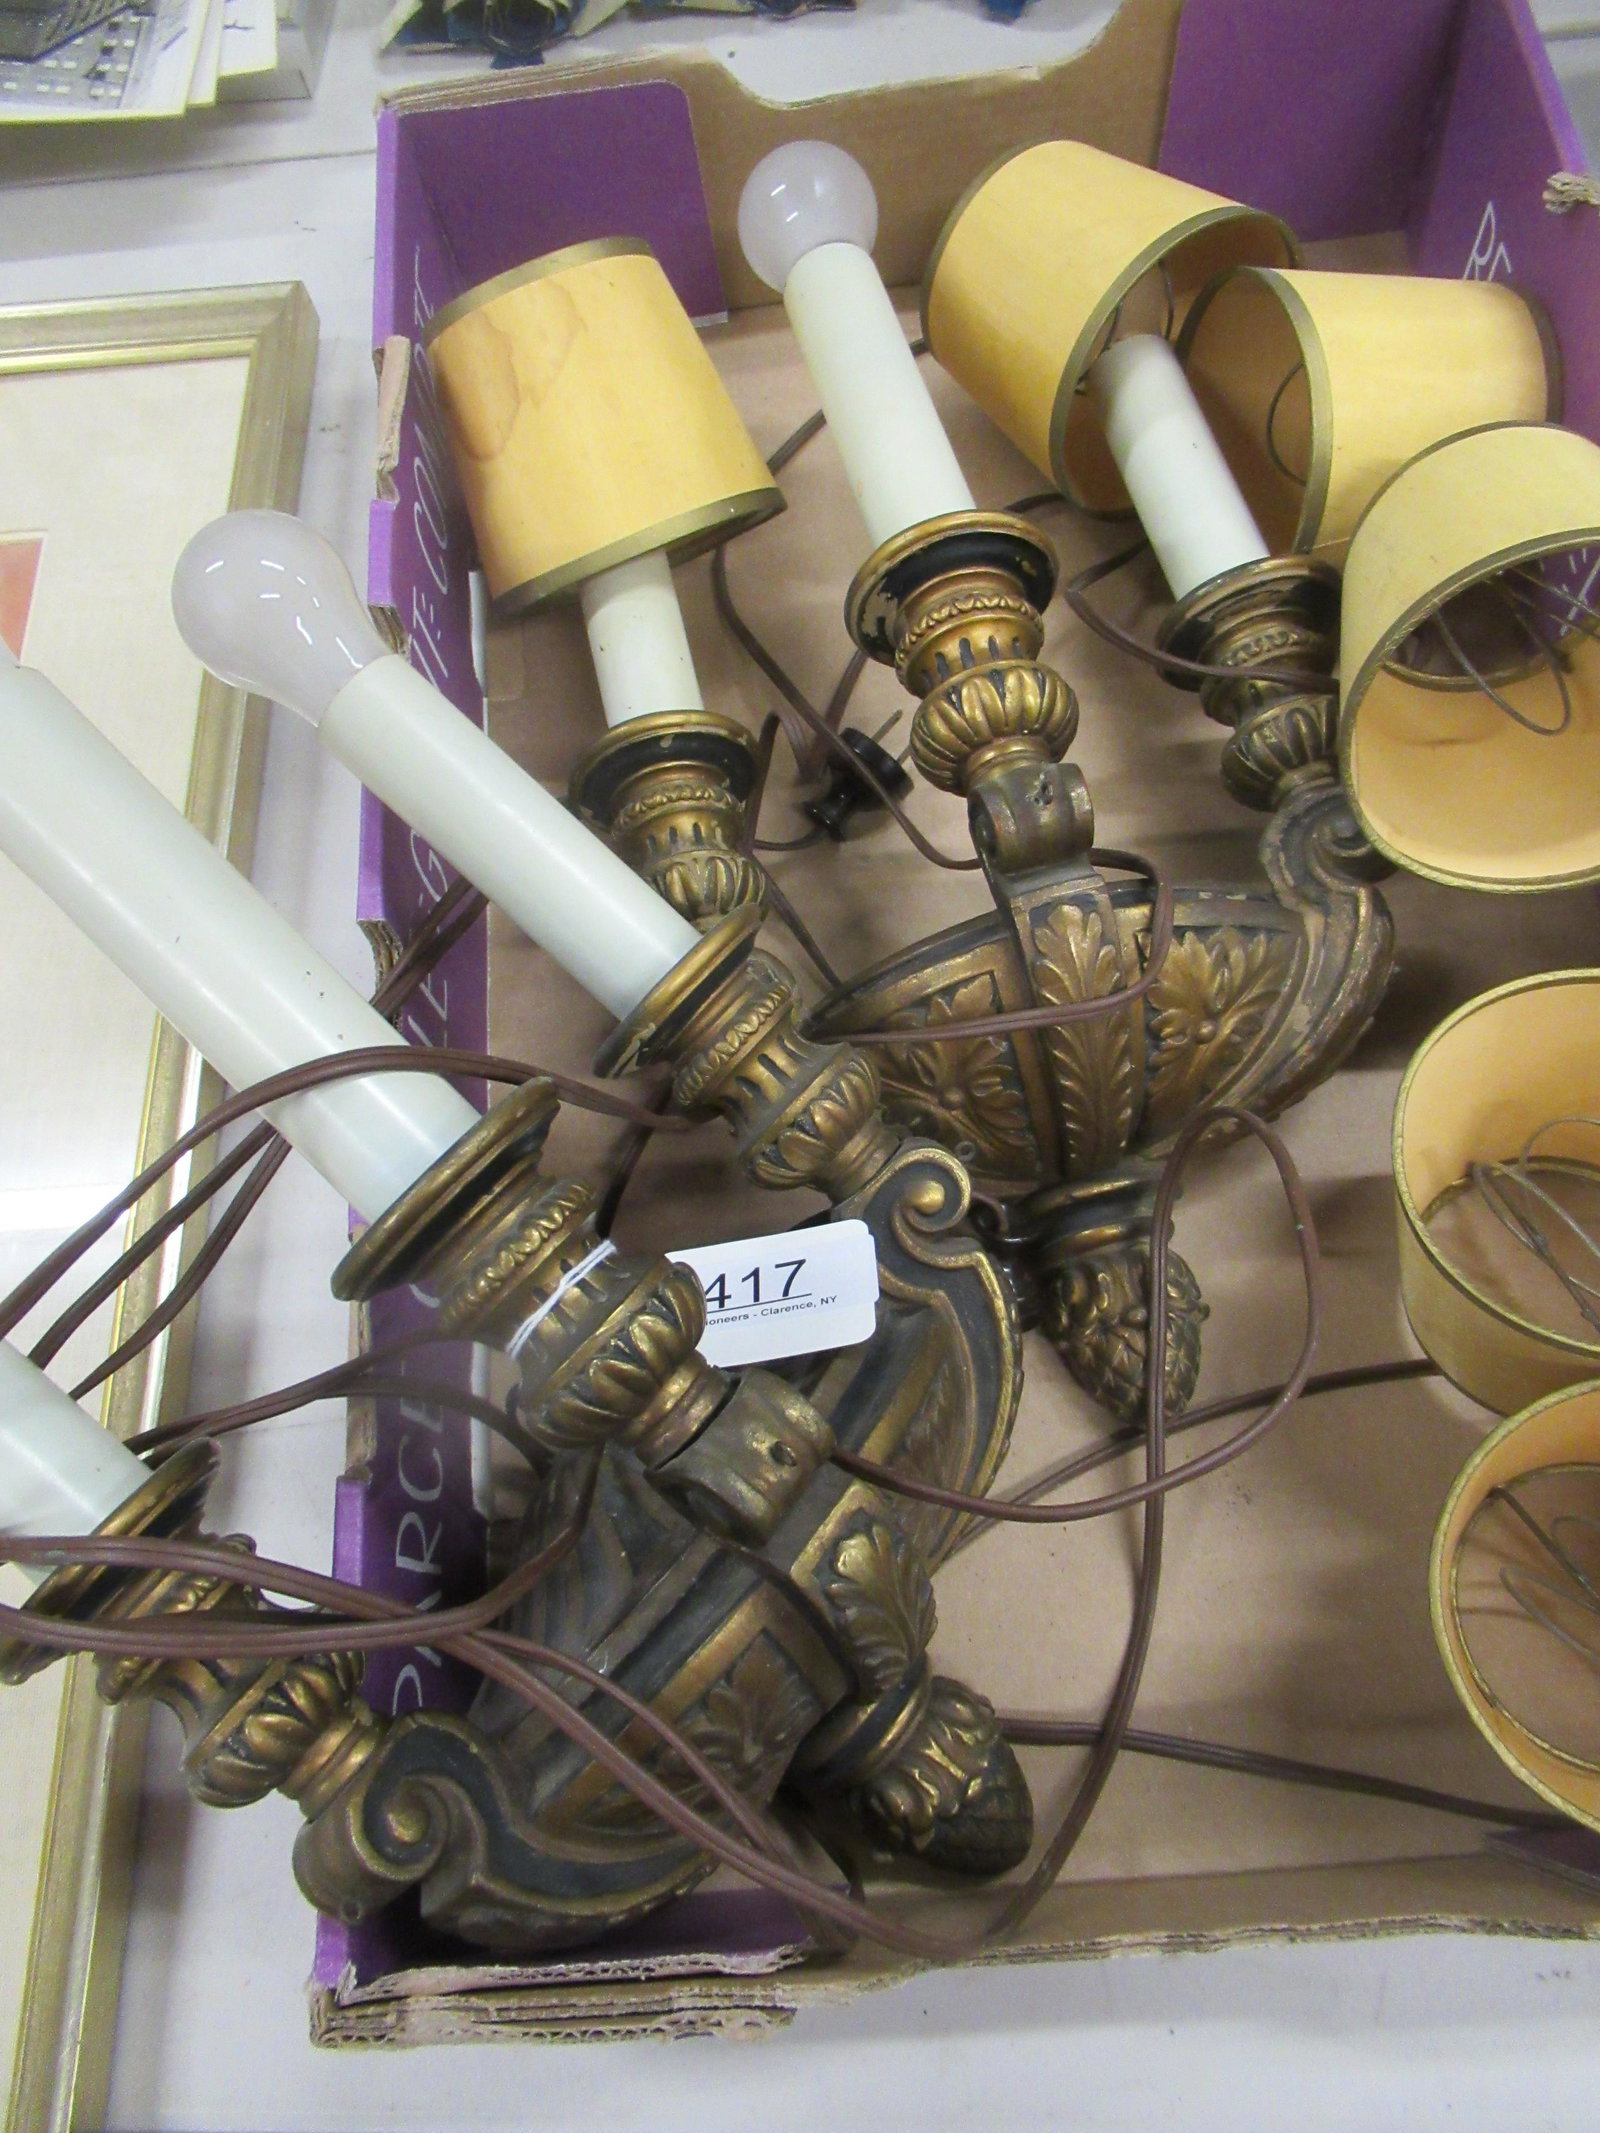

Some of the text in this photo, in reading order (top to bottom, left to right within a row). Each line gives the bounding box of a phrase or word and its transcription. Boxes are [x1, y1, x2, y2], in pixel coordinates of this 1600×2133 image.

[705, 1258, 807, 1309] 417
[705, 1313, 750, 1326] ioneers
[760, 1301, 817, 1317] Clarence,
[820, 1295, 838, 1305] NY
